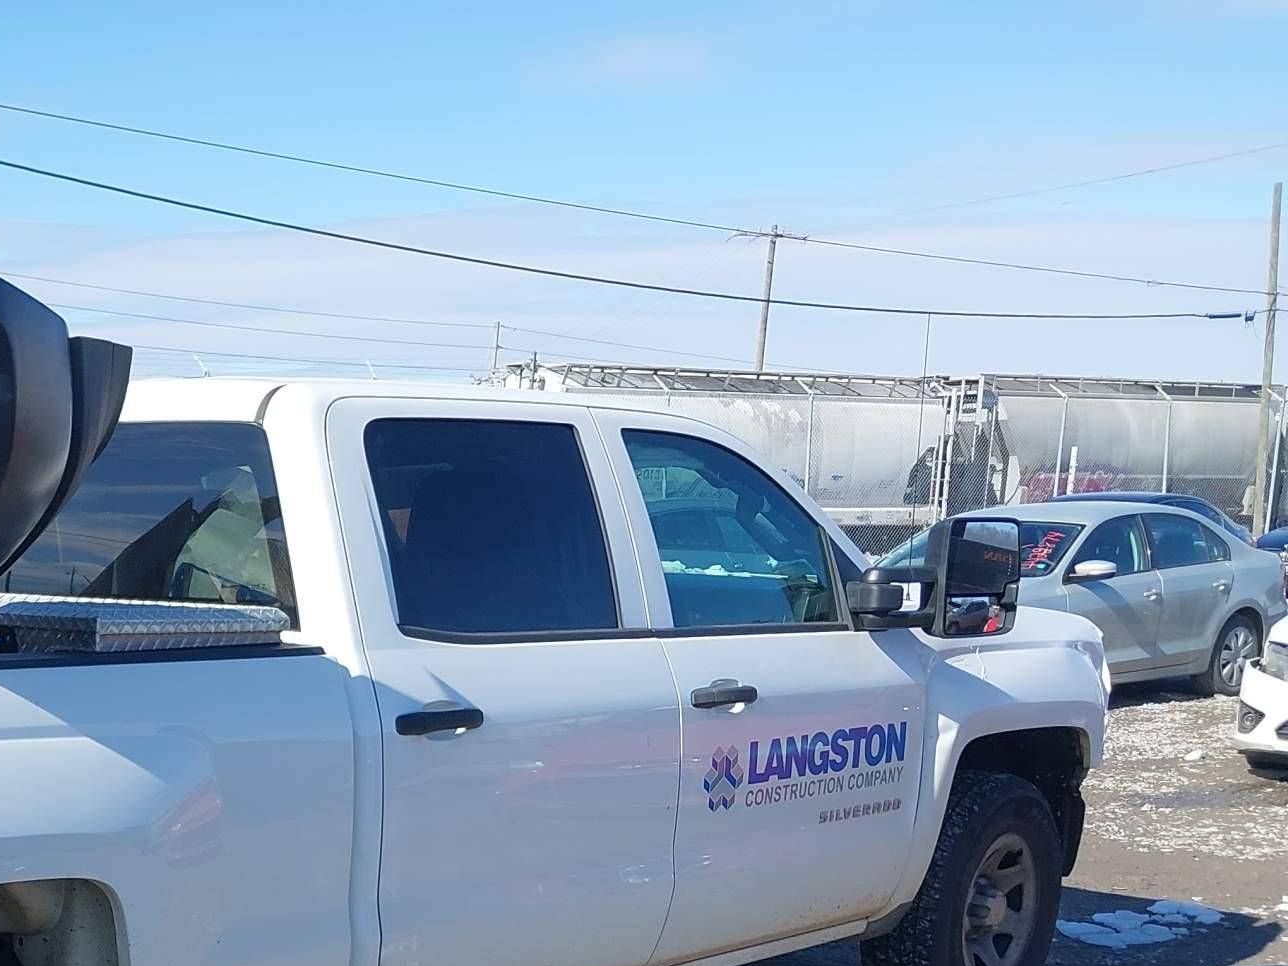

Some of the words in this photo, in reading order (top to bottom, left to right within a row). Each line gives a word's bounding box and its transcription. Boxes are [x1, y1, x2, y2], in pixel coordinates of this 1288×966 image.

[747, 721, 907, 785] LANGSTON
[744, 776, 846, 808] CONSTRUCTION
[847, 766, 905, 791] COMPANY
[818, 799, 902, 824] SILVERADO
